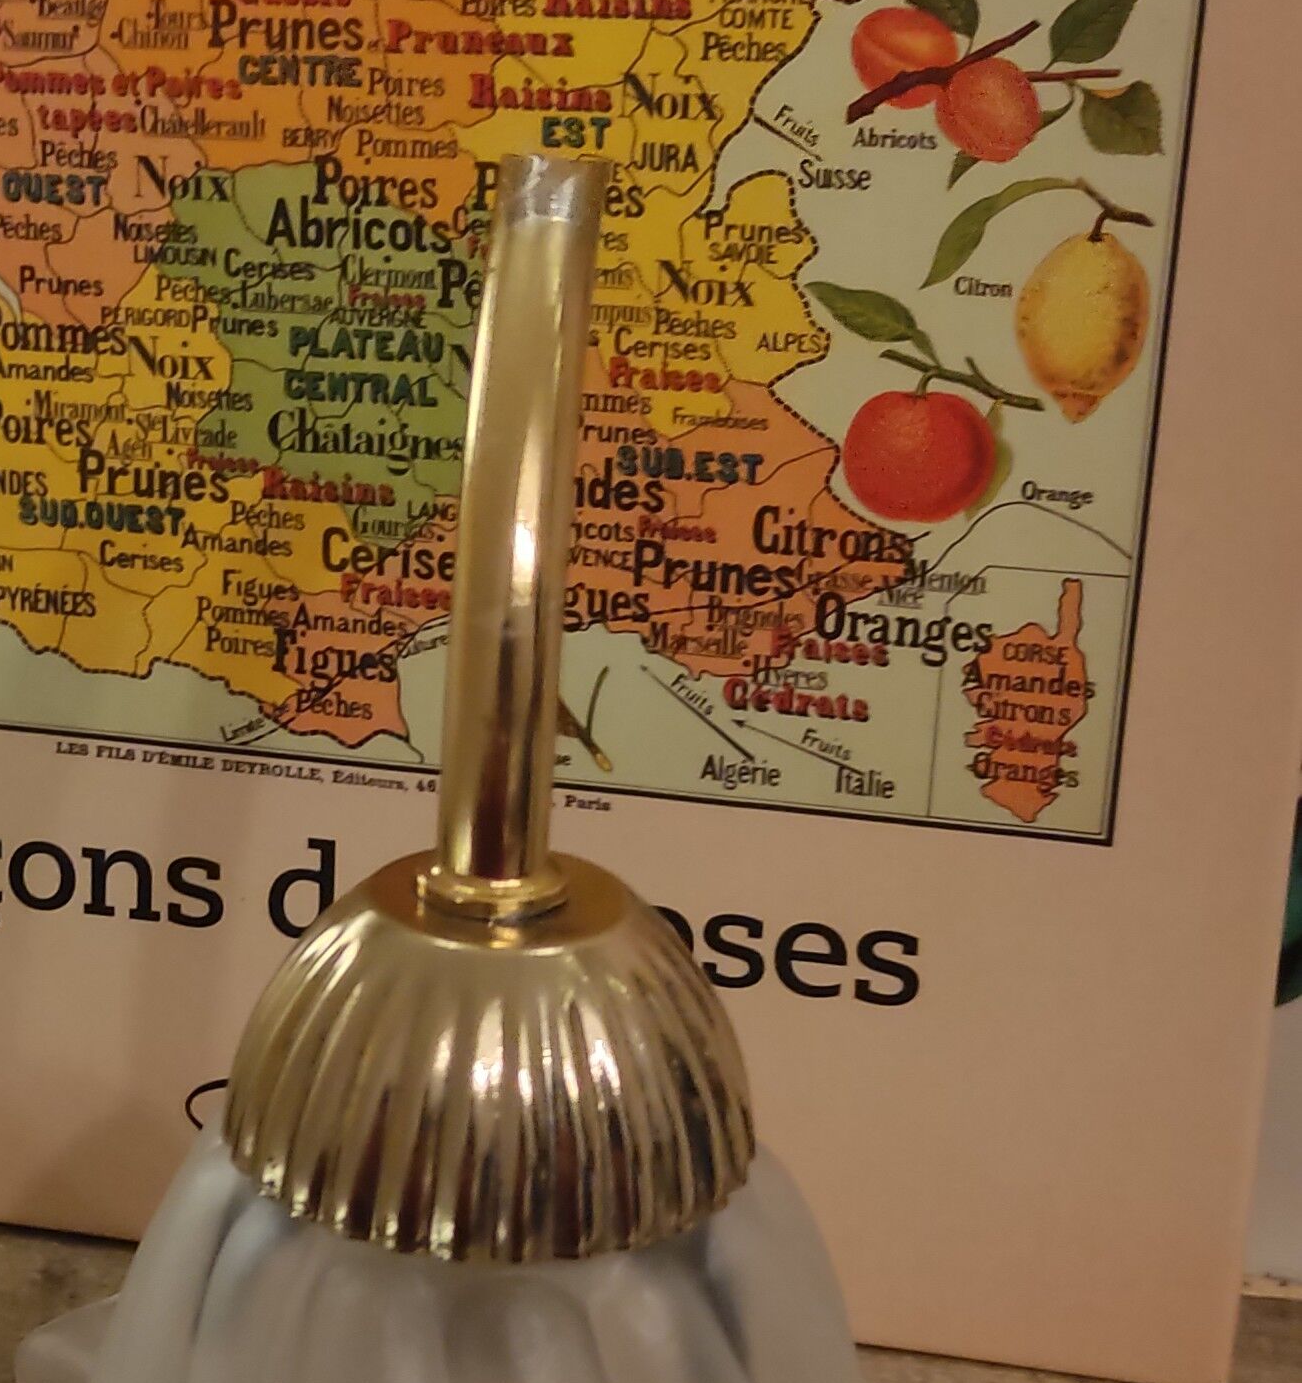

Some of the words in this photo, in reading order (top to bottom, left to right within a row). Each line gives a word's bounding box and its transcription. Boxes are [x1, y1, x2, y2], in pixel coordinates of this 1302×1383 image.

[718, 9, 794, 31] COMTE
[386, 19, 575, 58] Pruneaux
[700, 30, 789, 64] Pêches
[236, 55, 363, 89] CENTRE
[367, 66, 446, 97] Poires
[468, 72, 613, 113] Raisins
[622, 72, 723, 122] Noix
[327, 96, 426, 126] Noisettes
[356, 128, 459, 160] Pommes
[540, 116, 613, 150] EST
[851, 126, 939, 151] Abricots
[635, 140, 700, 174] JURA
[798, 157, 873, 192] Suisse
[135, 155, 234, 204] Noix
[311, 153, 440, 210] Poires
[265, 195, 454, 254] Abricots
[702, 209, 806, 246] Prunes
[19, 265, 105, 298] Prunes
[224, 249, 317, 283] Cerises
[658, 258, 755, 308] Noix
[953, 275, 1014, 299] Citron
[191, 303, 279, 339] Prunes
[127, 335, 217, 383] Noix
[289, 326, 446, 364] PLATEAU
[613, 326, 712, 361] Cerises
[755, 332, 822, 355] ALPES
[283, 369, 440, 409] CENTRAL
[78, 449, 232, 504] Prunes
[261, 465, 397, 507] Raisins
[1021, 479, 1094, 507] Orange
[182, 521, 294, 557] Amandes
[752, 504, 916, 565] Citrons
[99, 538, 186, 574] Cerises
[632, 538, 798, 598] Prunes
[222, 569, 301, 605] Figues
[291, 603, 410, 639] Amandes
[814, 591, 996, 668] Oranges
[272, 627, 399, 687] Figues
[1001, 642, 1069, 666] CORSE
[961, 664, 1096, 700] Amandes
[55, 740, 89, 756] LES
[95, 744, 136, 762] FILS
[221, 757, 325, 784] DEYROLLE,
[700, 754, 782, 790] Algérie
[832, 763, 895, 800] Italie
